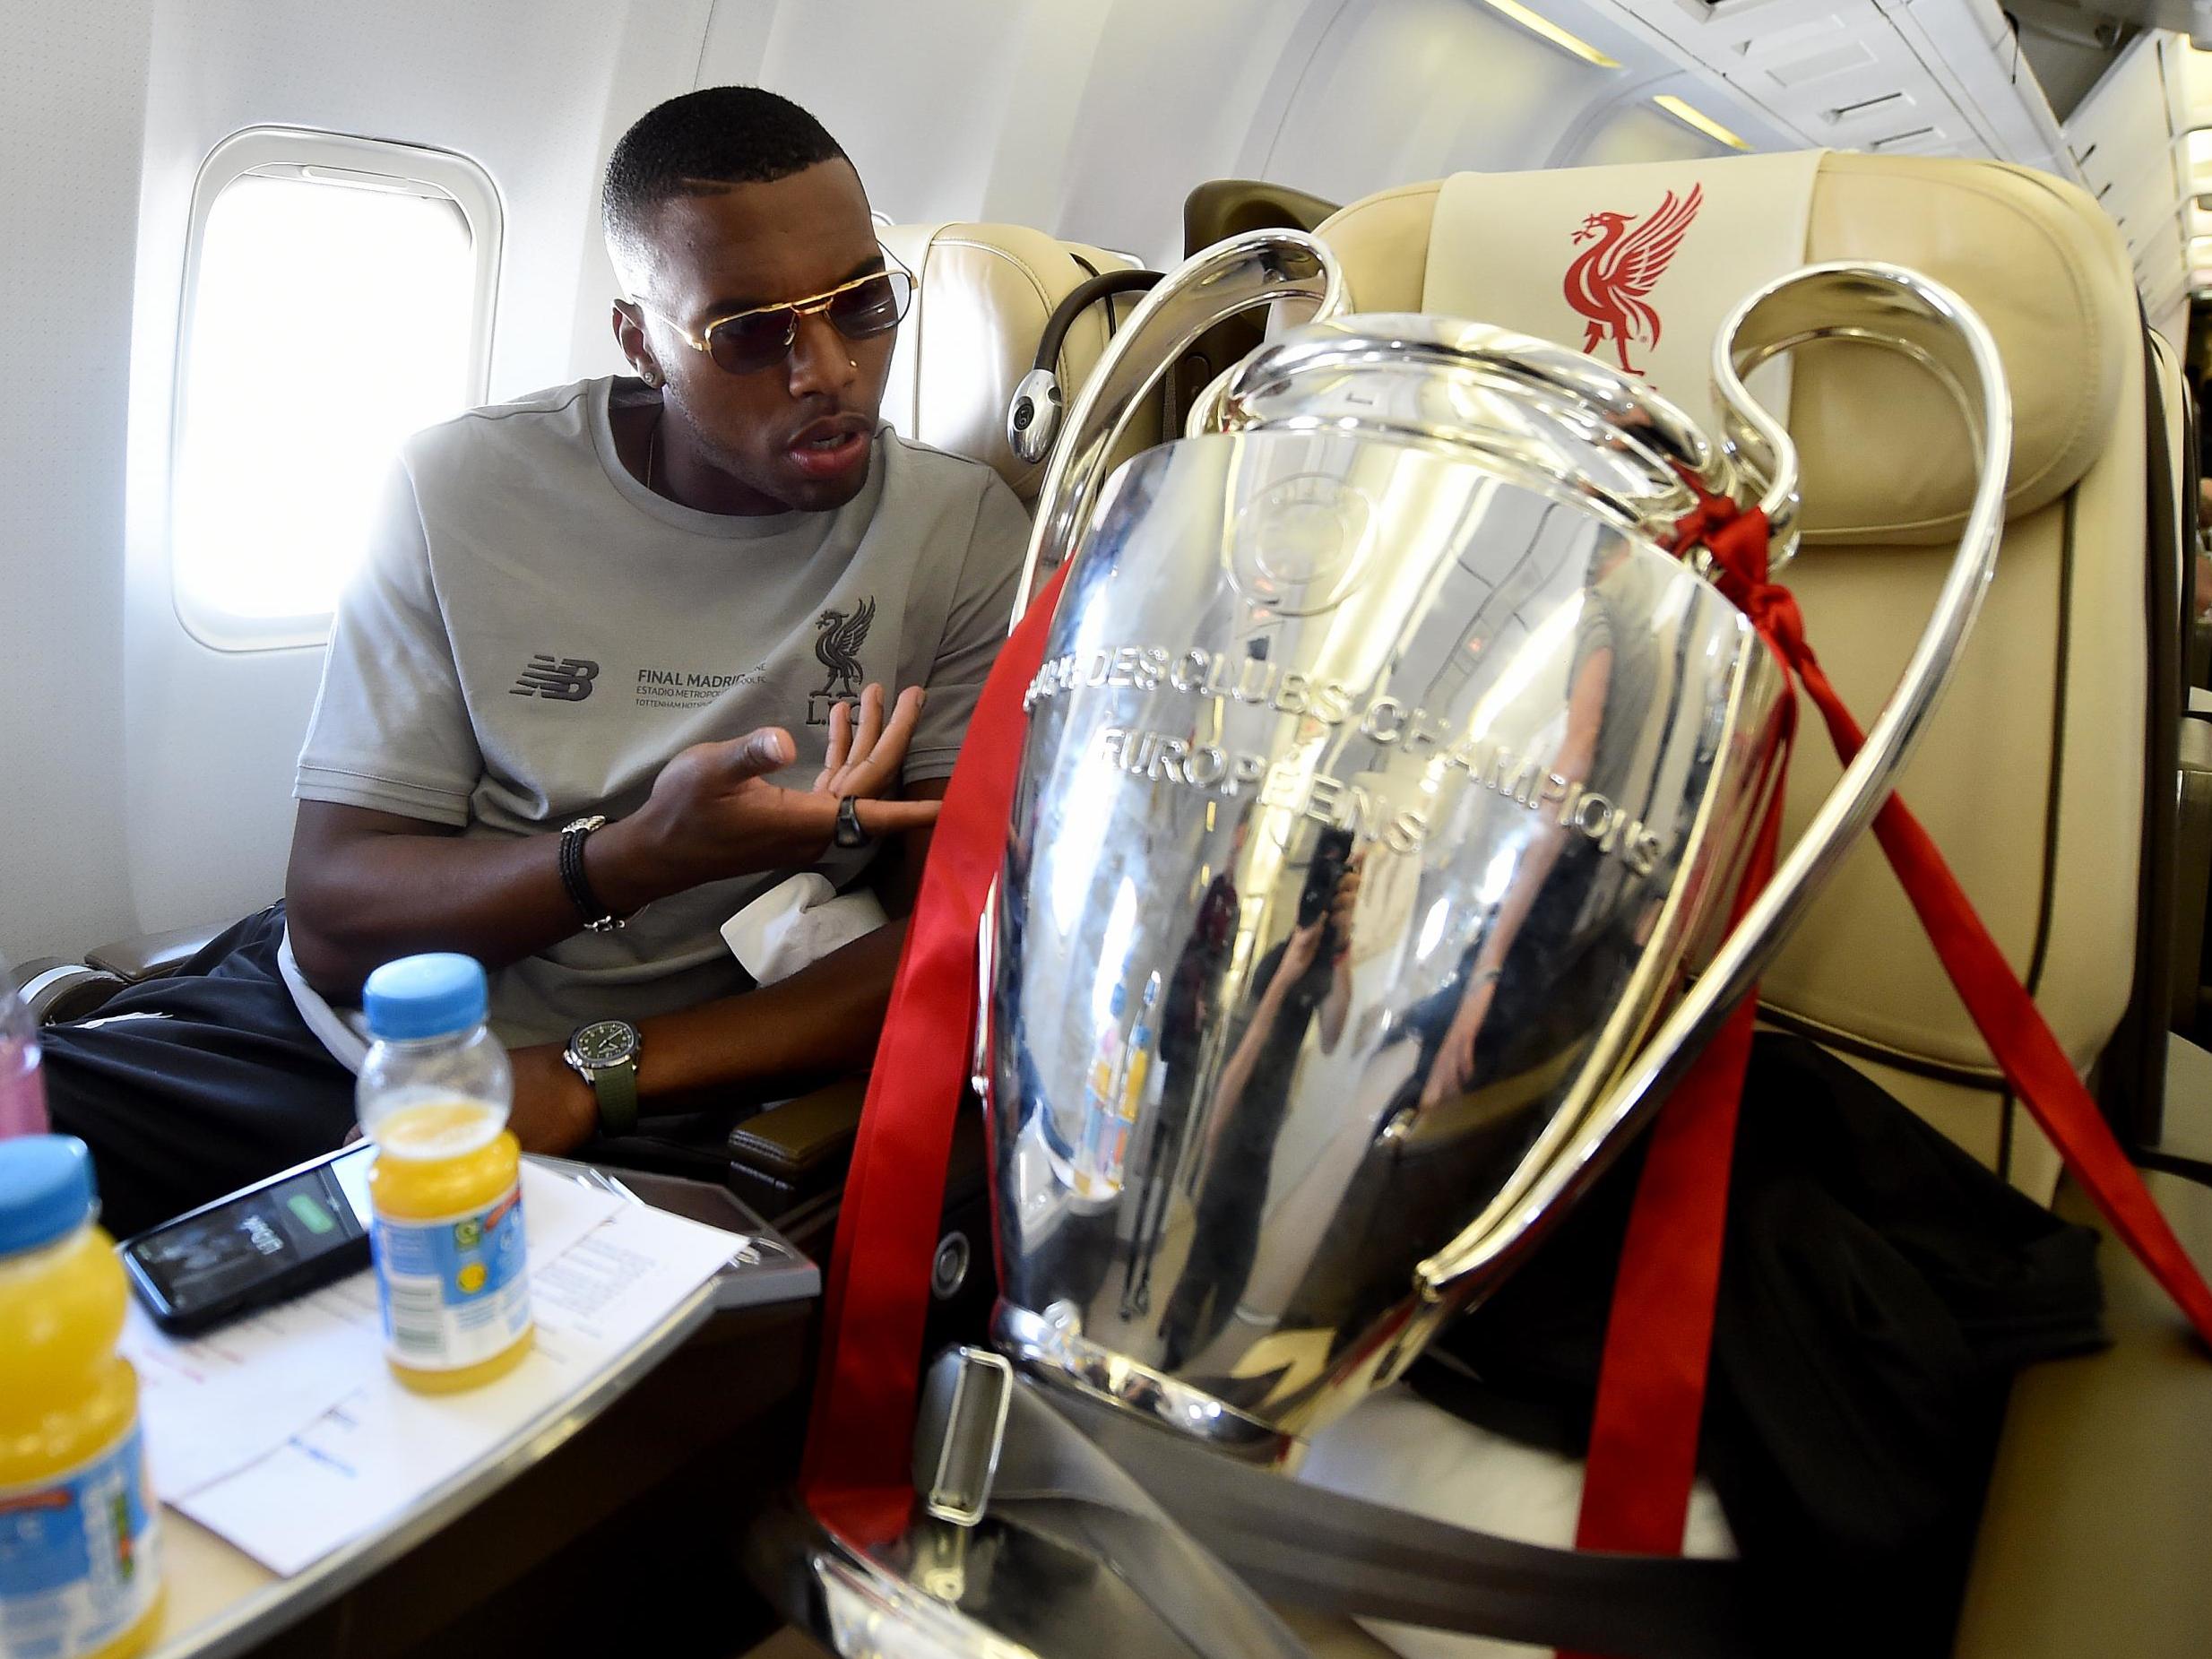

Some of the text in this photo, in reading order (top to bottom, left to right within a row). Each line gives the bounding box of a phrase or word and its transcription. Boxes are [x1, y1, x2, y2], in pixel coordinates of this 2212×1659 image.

[637, 669, 683, 687] FINAL
[635, 685, 675, 697] ESTADIO
[635, 698, 680, 708] TOTTENHAM
[1170, 647, 1352, 726] CLUBS
[1360, 696, 1660, 876] CHAMPIONS
